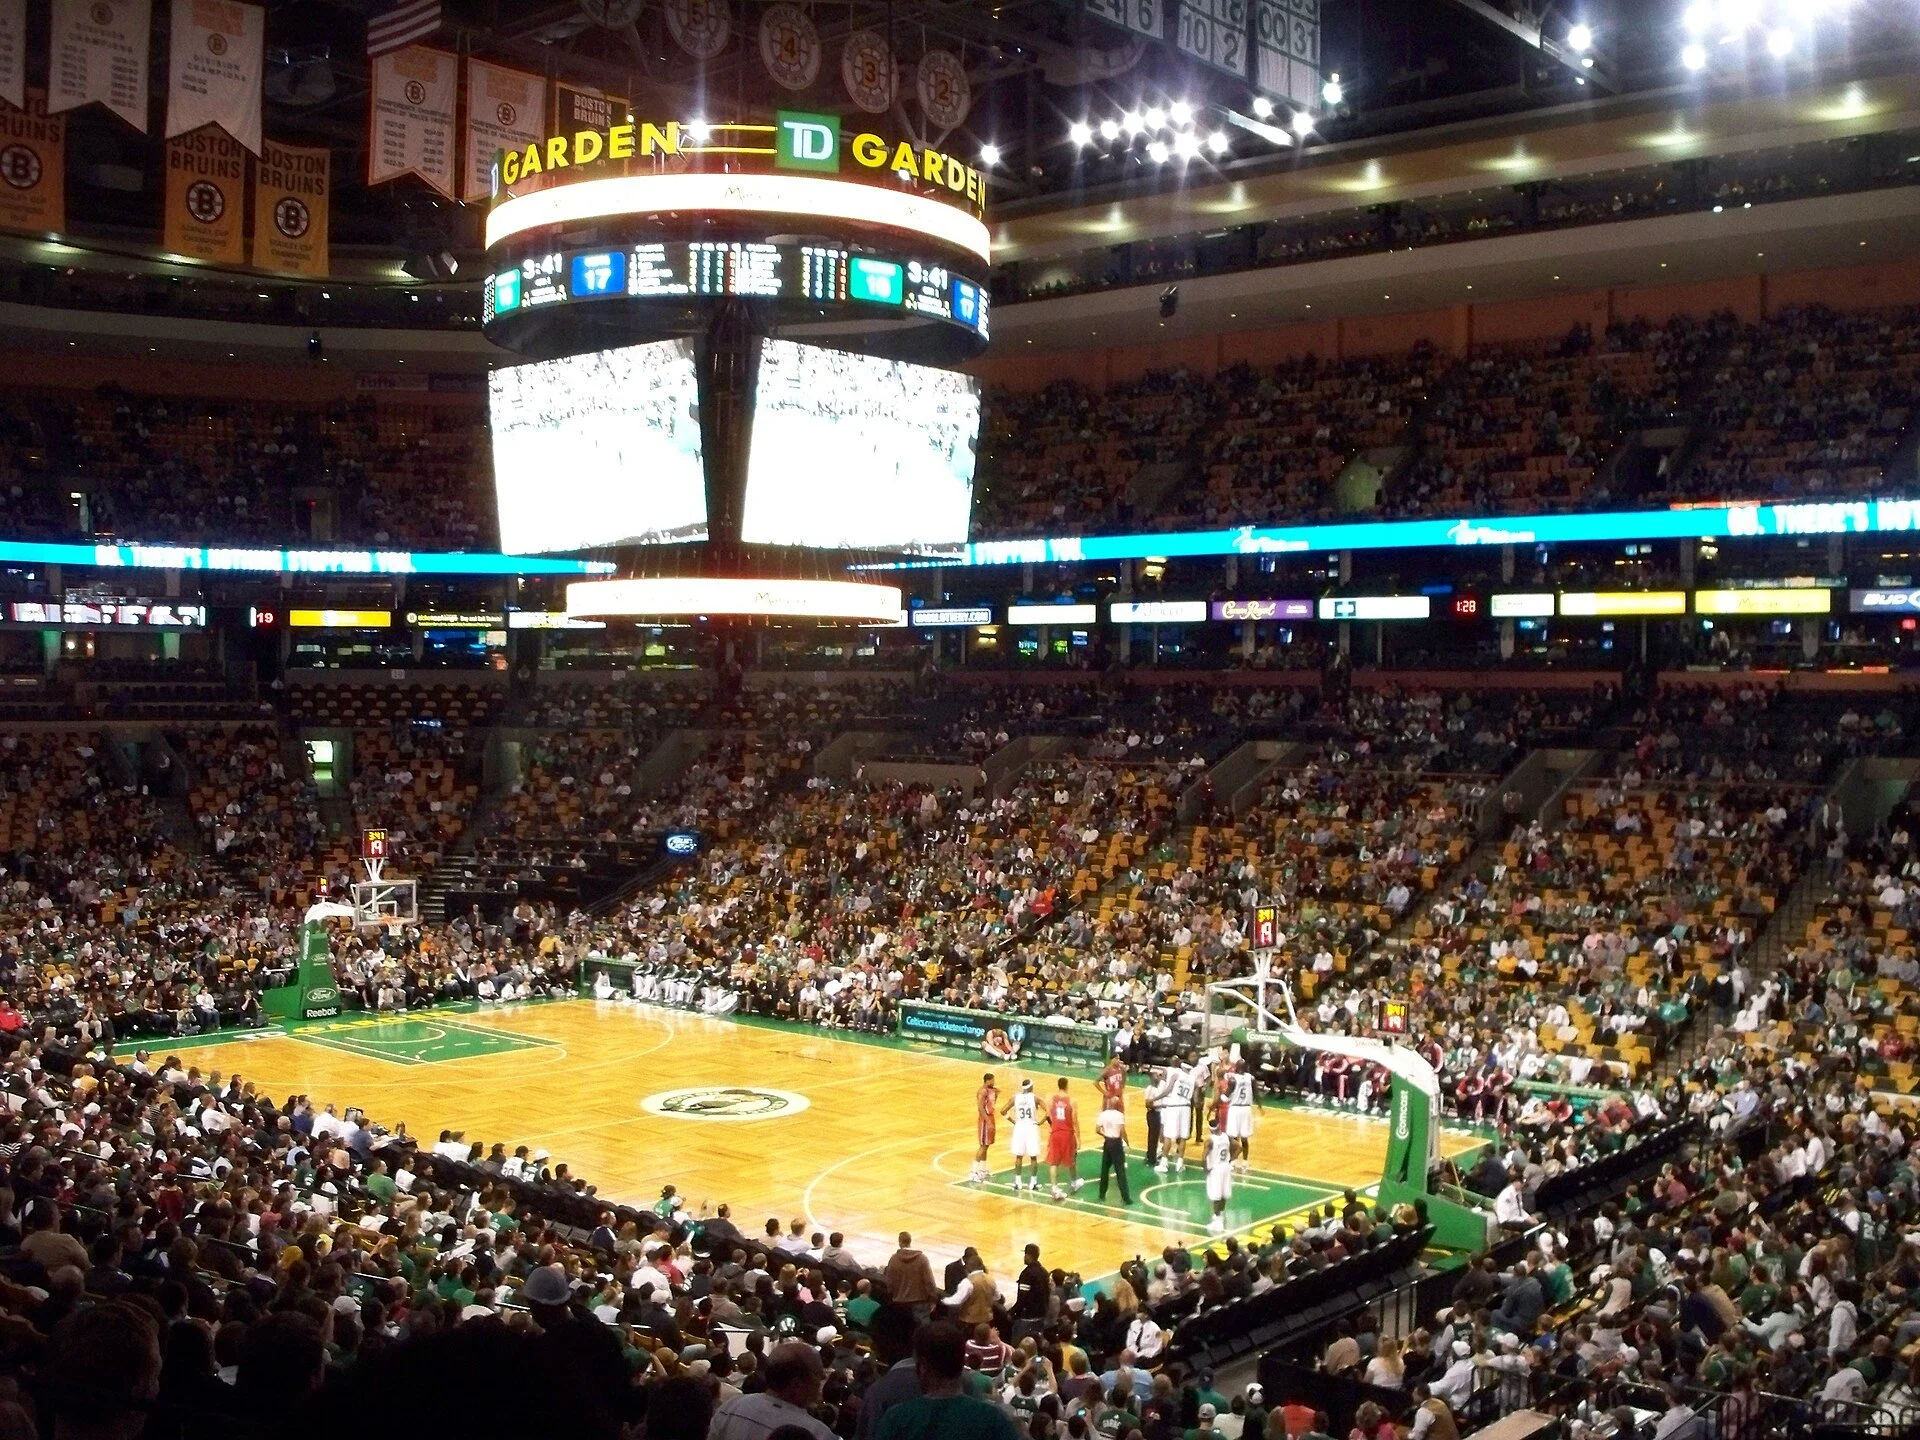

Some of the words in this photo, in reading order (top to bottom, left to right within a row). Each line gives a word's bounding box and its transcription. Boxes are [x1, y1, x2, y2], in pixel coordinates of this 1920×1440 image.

[1183, 13, 1208, 55] 10
[1258, 5, 1286, 46] 00
[782, 35, 797, 59] 4
[1223, 32, 1238, 70] 2
[1293, 22, 1318, 61] 31
[864, 62, 878, 84] 3
[574, 94, 612, 115] BOSTON
[573, 108, 612, 128] BRUINS
[503, 120, 680, 185] GARDEN
[783, 120, 835, 161] TD
[170, 150, 241, 179] BRUINS
[261, 147, 326, 176] BOSTON
[853, 133, 987, 212] GARDEN
[260, 167, 325, 196] BRUINS
[584, 268, 612, 291] 17
[1456, 600, 1476, 613] 1:28
[1863, 593, 1908, 606] BUD
[256, 612, 273, 624] 19
[306, 1007, 338, 1018] Reebok
[1246, 1032, 1280, 1043] Comcast
[1177, 1086, 1190, 1098] 30
[1019, 1107, 1032, 1120] 34
[1395, 1090, 1409, 1140] Comcast
